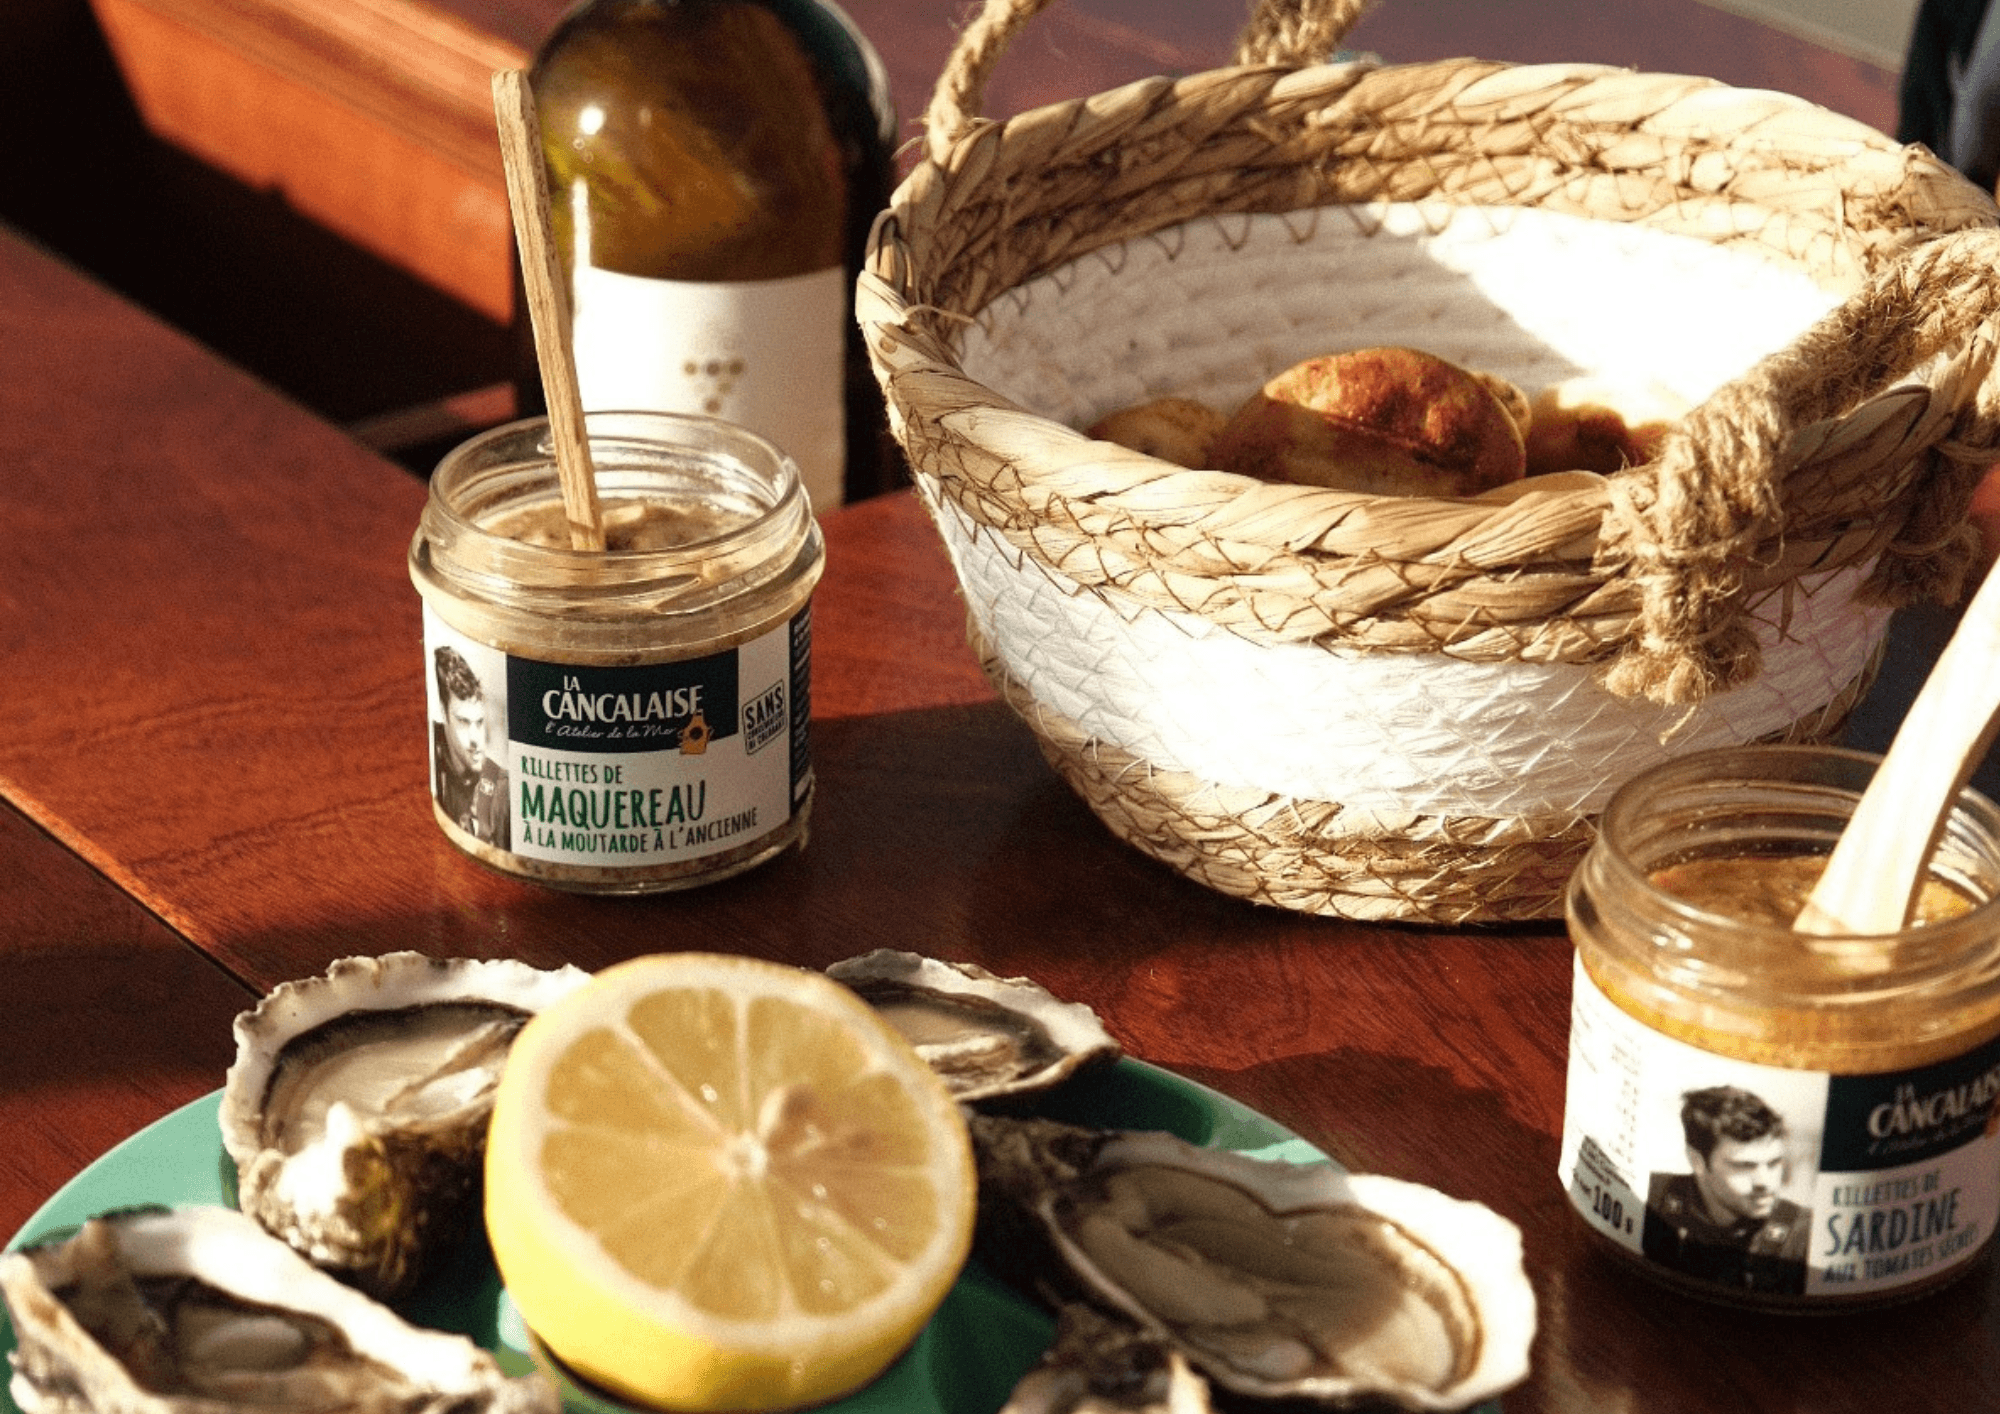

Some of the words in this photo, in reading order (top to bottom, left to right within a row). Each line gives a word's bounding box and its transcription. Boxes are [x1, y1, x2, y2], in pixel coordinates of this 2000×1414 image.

[542, 684, 704, 723] CANCALAISE
[563, 674, 581, 692] LA
[745, 686, 783, 730] SANS
[606, 725, 623, 738] de
[626, 724, 640, 738] la
[643, 723, 678, 736] Mer
[521, 755, 598, 784] RILLETTES
[603, 765, 623, 784] DE
[521, 779, 706, 831] MAQUEREAU
[523, 819, 533, 844] À
[538, 827, 557, 848] LA
[561, 830, 649, 853] MOUTARDE
[653, 827, 664, 851] À
[670, 806, 758, 849] L'ANCIENNE
[1867, 1065, 2000, 1139] CANCALAIS
[1824, 1187, 1962, 1257] SARDINE
